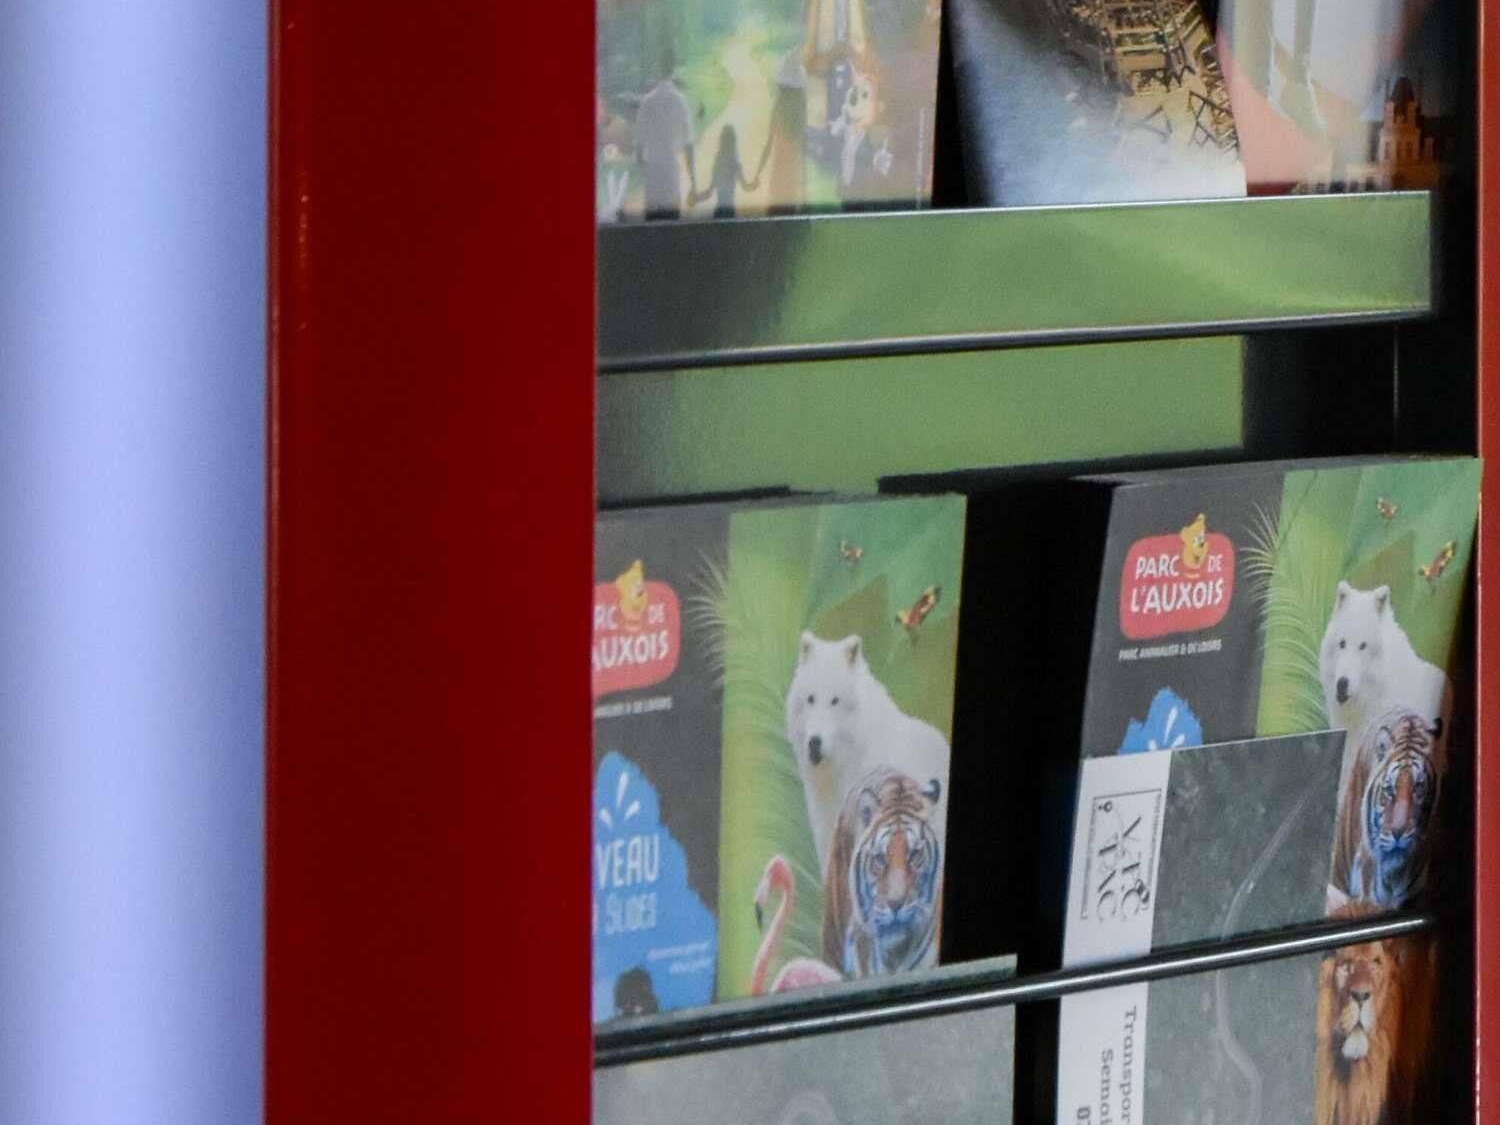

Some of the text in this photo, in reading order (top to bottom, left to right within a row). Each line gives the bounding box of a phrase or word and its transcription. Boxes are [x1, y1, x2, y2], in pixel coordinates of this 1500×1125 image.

[1135, 552, 1224, 580] PARC DE
[1130, 578, 1225, 615] L'AUXOIS
[648, 601, 665, 624] DE
